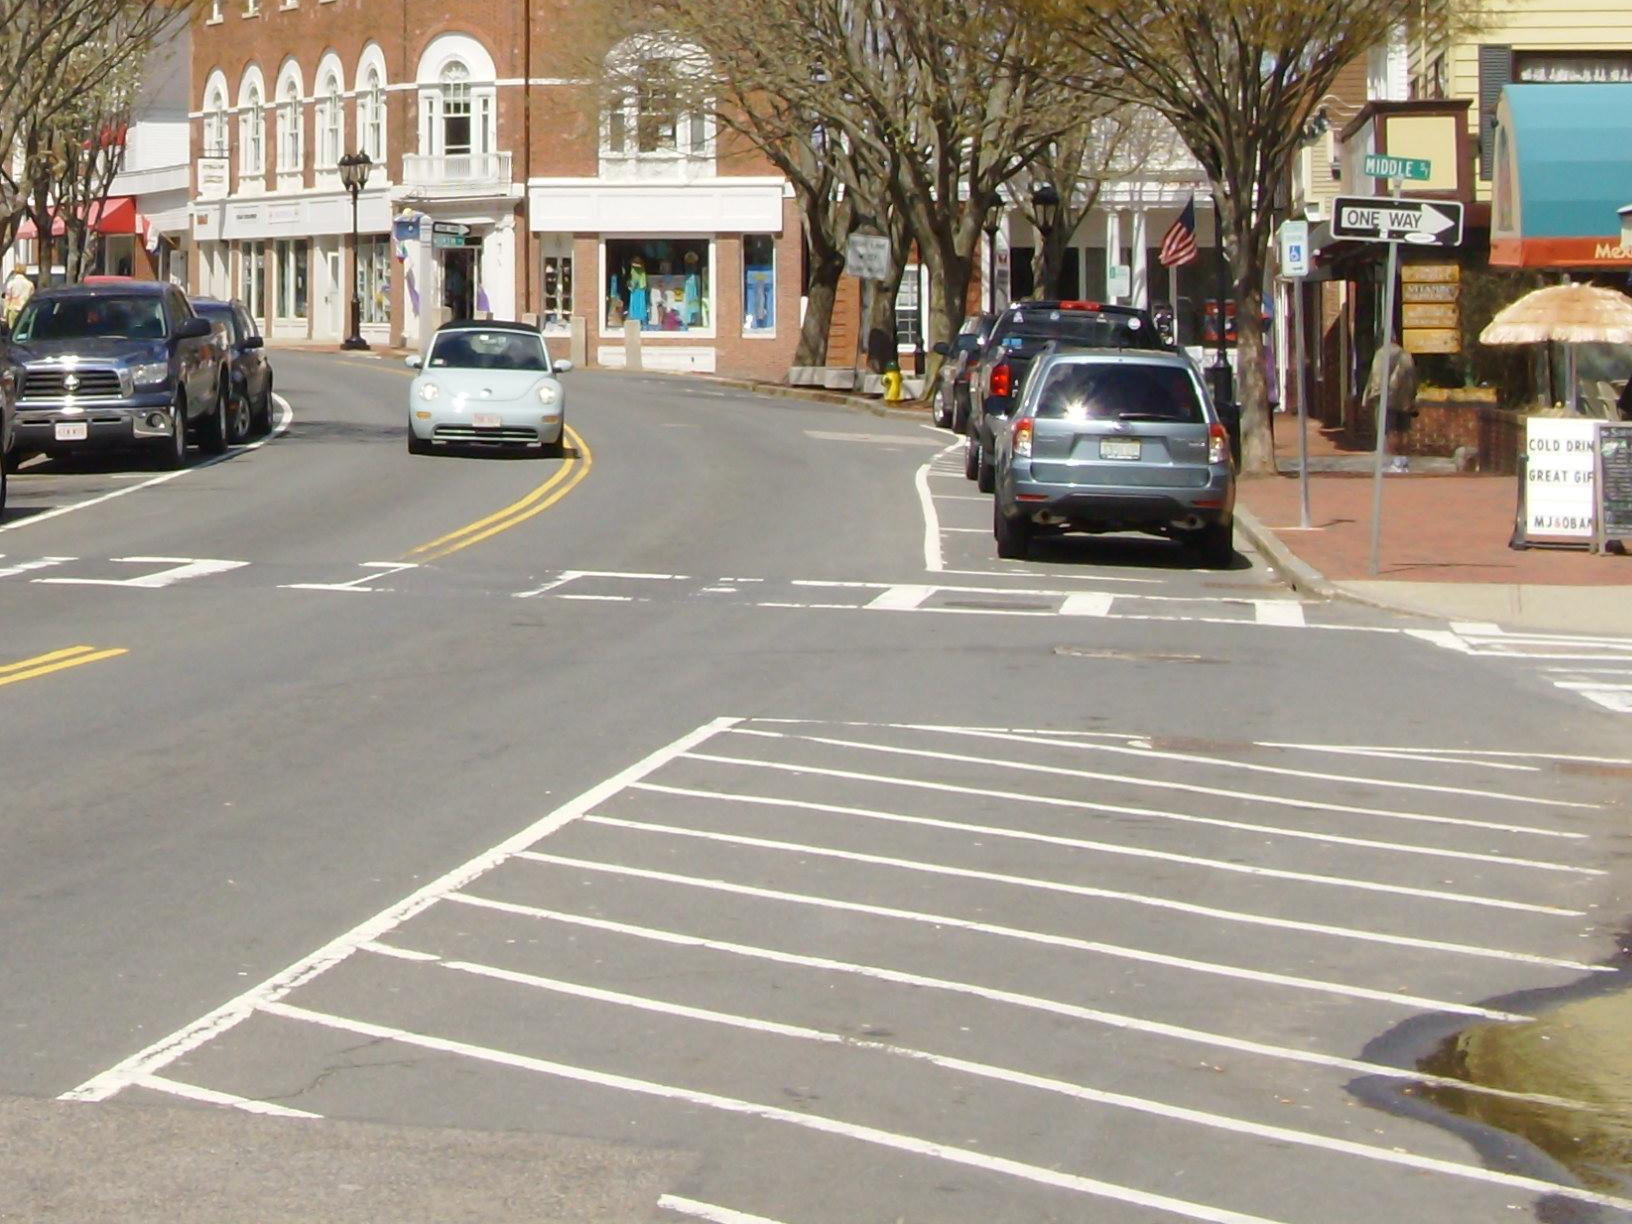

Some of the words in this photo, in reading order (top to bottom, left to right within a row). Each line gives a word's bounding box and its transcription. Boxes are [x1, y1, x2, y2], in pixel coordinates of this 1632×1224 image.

[1365, 156, 1414, 177] MIDDLE
[1347, 210, 1380, 226] ONE
[1388, 212, 1423, 229] WAY
[1529, 439, 1560, 452] COLD
[1529, 469, 1568, 482] GREAT
